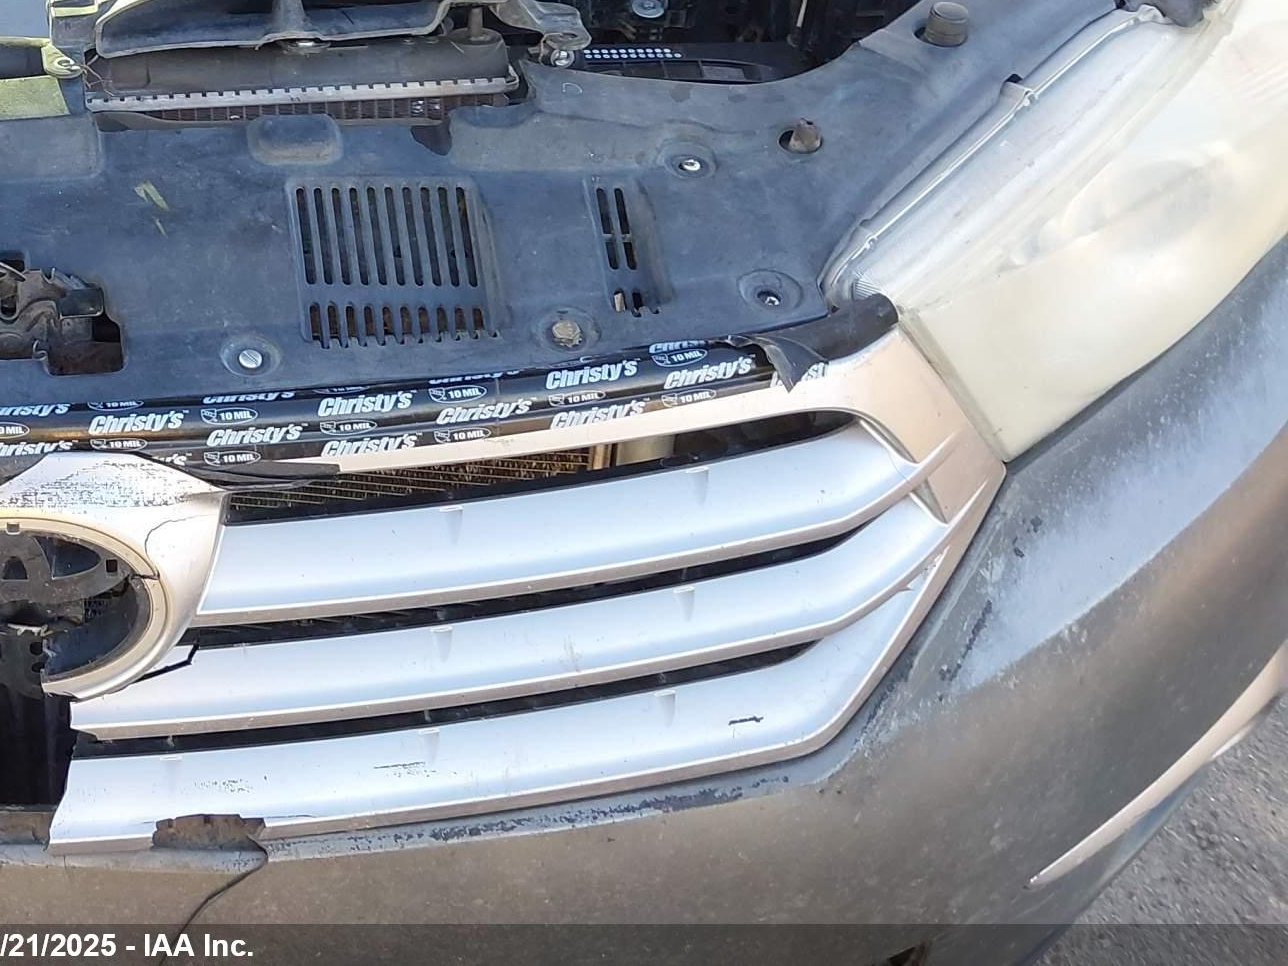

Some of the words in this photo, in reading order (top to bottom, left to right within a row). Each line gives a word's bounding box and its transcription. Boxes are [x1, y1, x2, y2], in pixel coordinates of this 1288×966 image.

[671, 353, 685, 362] 10
[684, 350, 703, 360] MIL
[545, 359, 638, 390] Christy's
[663, 357, 753, 390] Christy's
[447, 389, 460, 399] 10
[460, 387, 482, 397] MIL
[567, 394, 581, 403] 10
[581, 392, 599, 401] MIL
[679, 394, 693, 403] 10
[693, 391, 712, 401] MIL
[317, 391, 413, 417] Christy's
[219, 412, 233, 421] 10
[233, 410, 253, 420] MIL
[436, 399, 532, 425] Christy's
[88, 410, 185, 435] Christy's
[339, 424, 352, 432] 10
[352, 422, 371, 430] MIL
[6, 425, 26, 434] MIL
[206, 424, 303, 446] Christy's
[453, 432, 466, 441] 10
[465, 430, 485, 439] MIL
[109, 440, 122, 448] 10
[122, 440, 141, 448] MIL
[222, 454, 235, 463] 10
[235, 453, 255, 462] MIL
